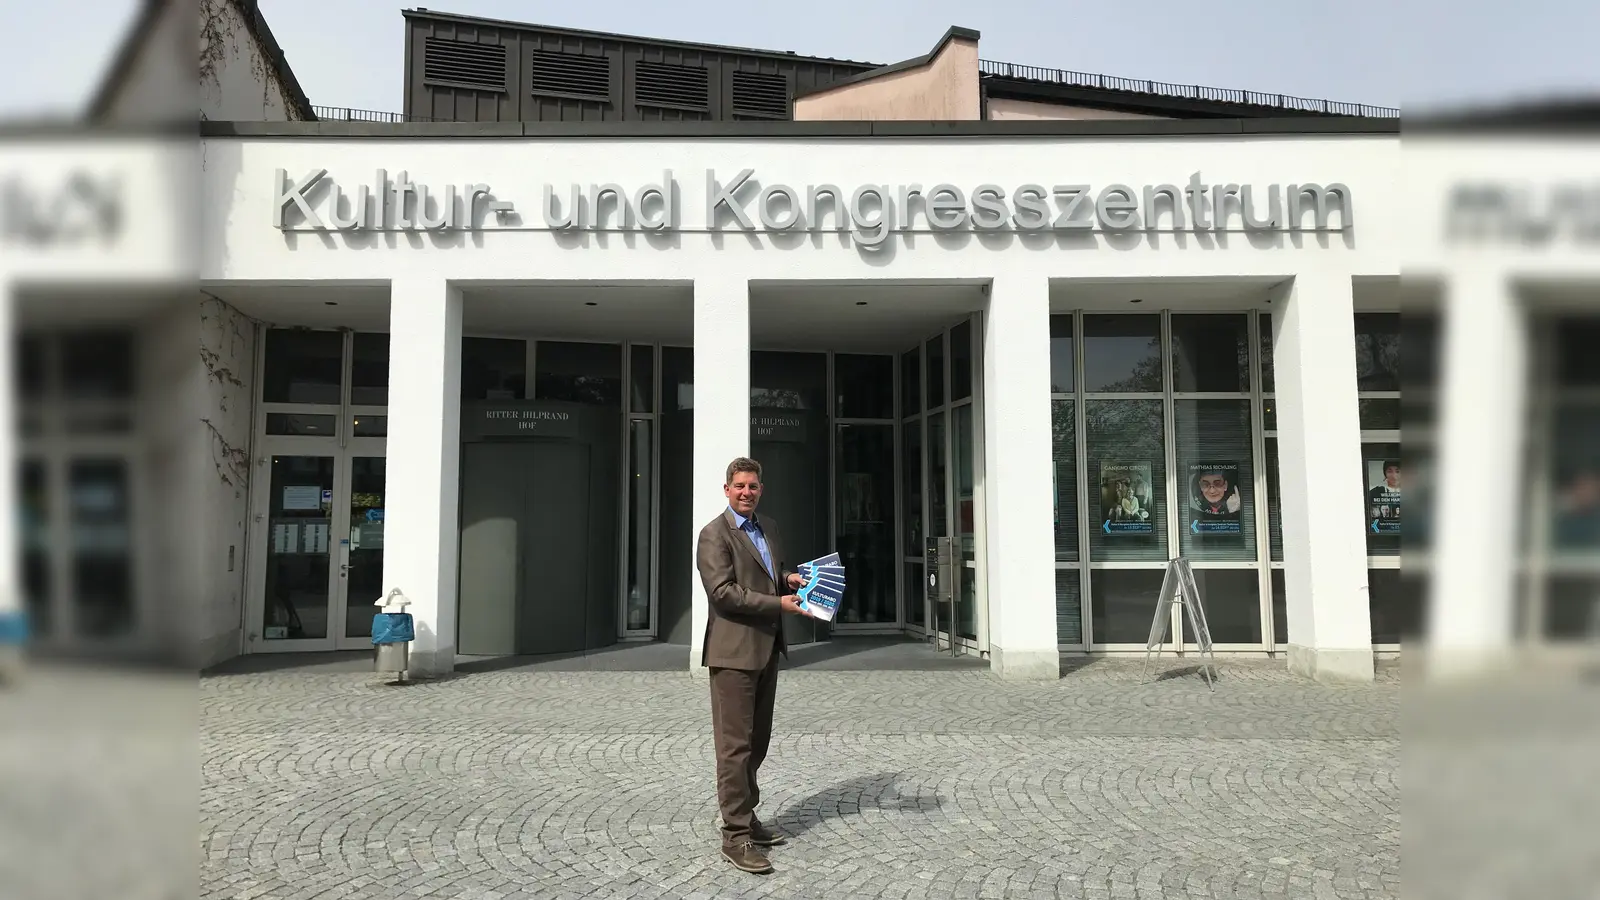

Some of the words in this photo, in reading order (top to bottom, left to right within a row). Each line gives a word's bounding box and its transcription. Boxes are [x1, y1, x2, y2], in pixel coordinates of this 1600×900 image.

[272, 168, 515, 229] Kultur-
[542, 168, 672, 230] und
[705, 168, 1354, 247] Kongresszentrum
[486, 410, 519, 419] RITTER
[522, 411, 569, 420] HILPRAND
[518, 421, 537, 429] HOF
[761, 417, 800, 426] HILPRAND
[757, 427, 774, 435] HOF
